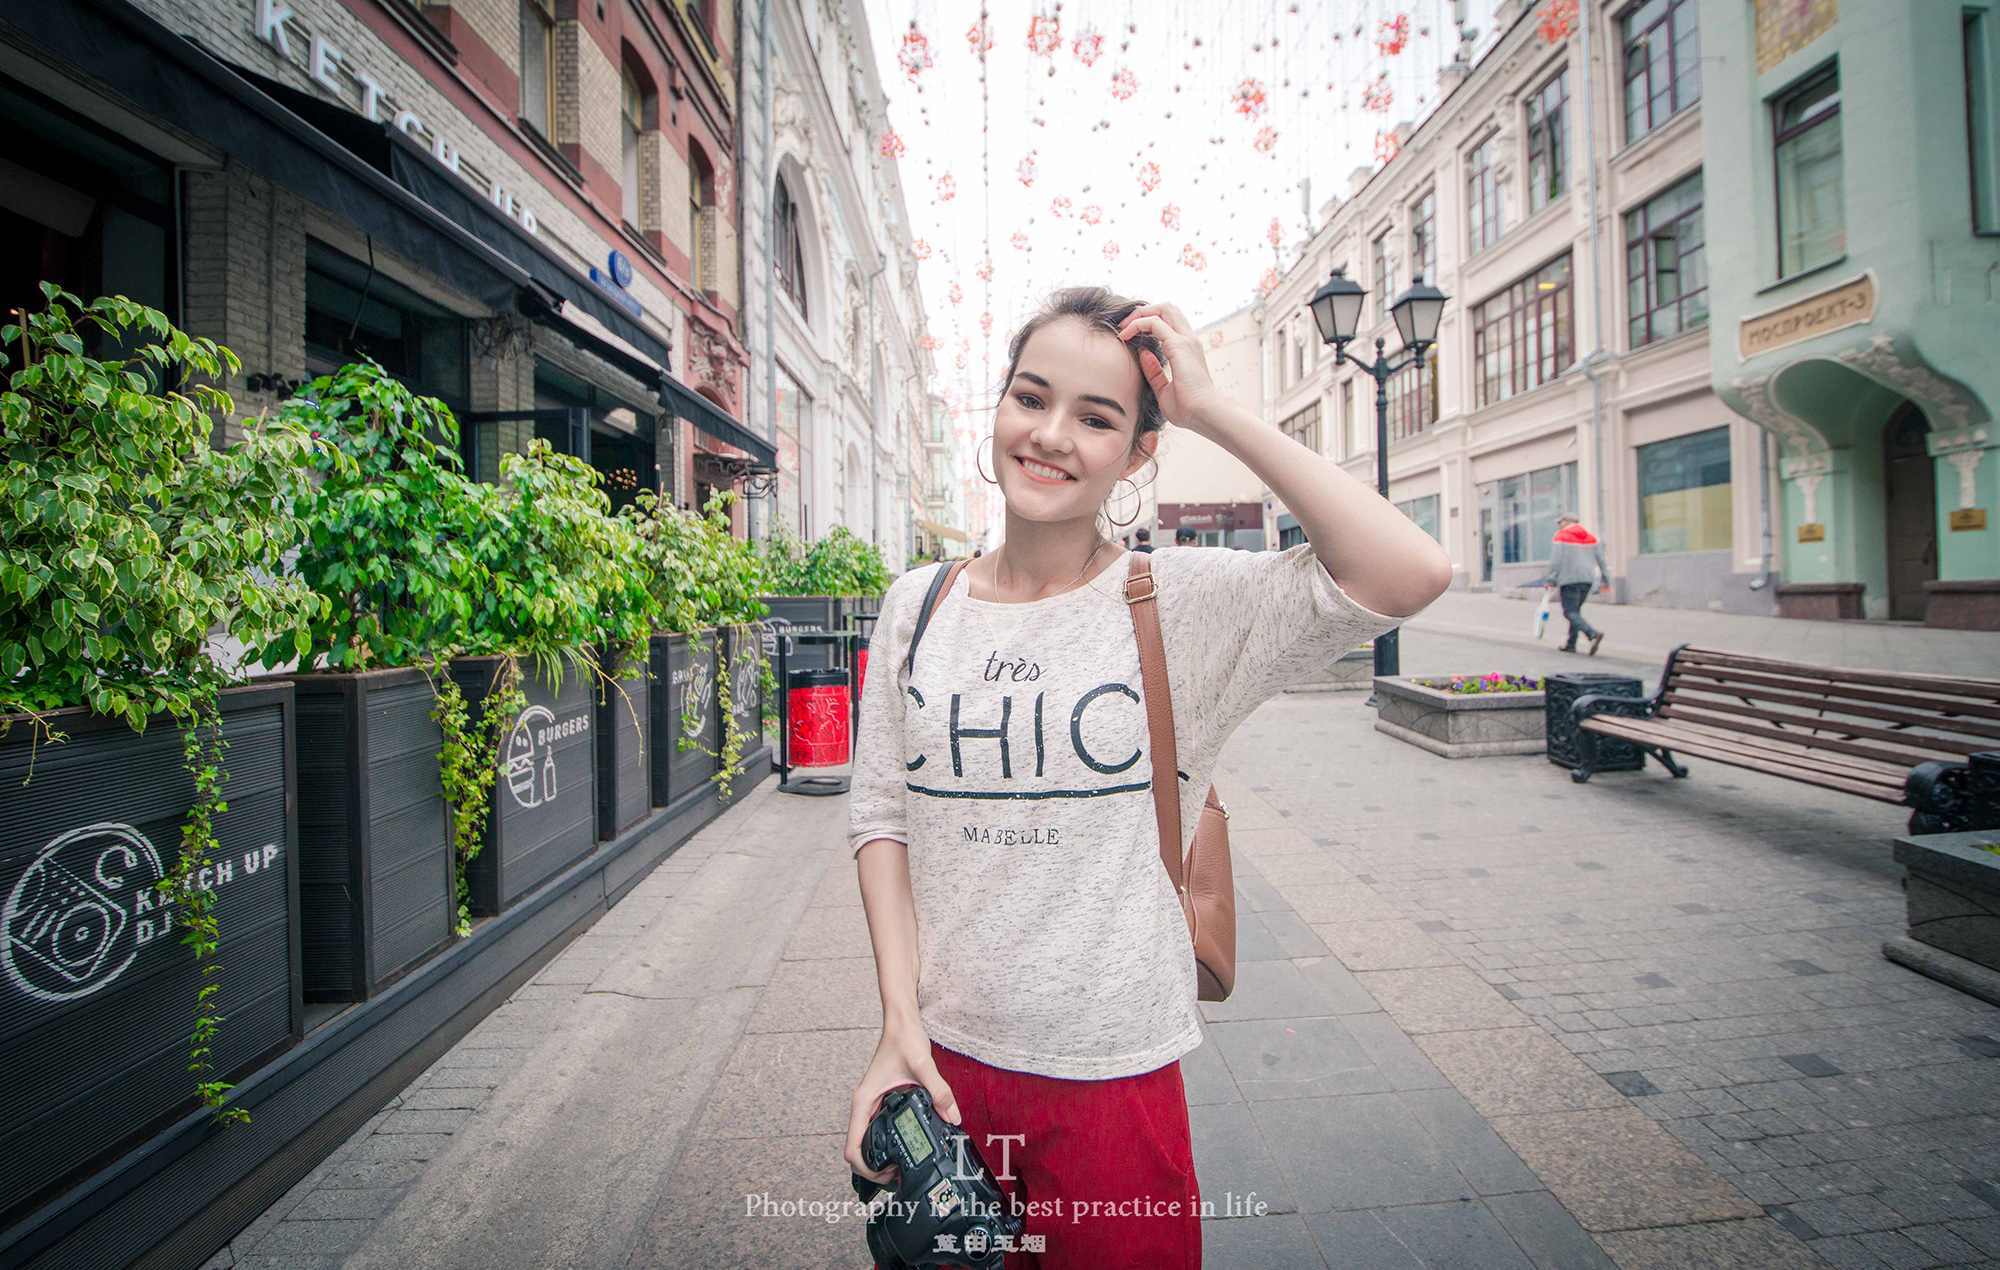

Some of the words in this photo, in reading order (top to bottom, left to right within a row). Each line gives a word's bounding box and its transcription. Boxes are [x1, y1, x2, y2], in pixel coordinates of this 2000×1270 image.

[984, 650, 1047, 682] très
[538, 714, 589, 746] BURGERS
[963, 826, 1060, 846] MABELLE
[244, 844, 278, 874] UP
[135, 911, 172, 944] DJ
